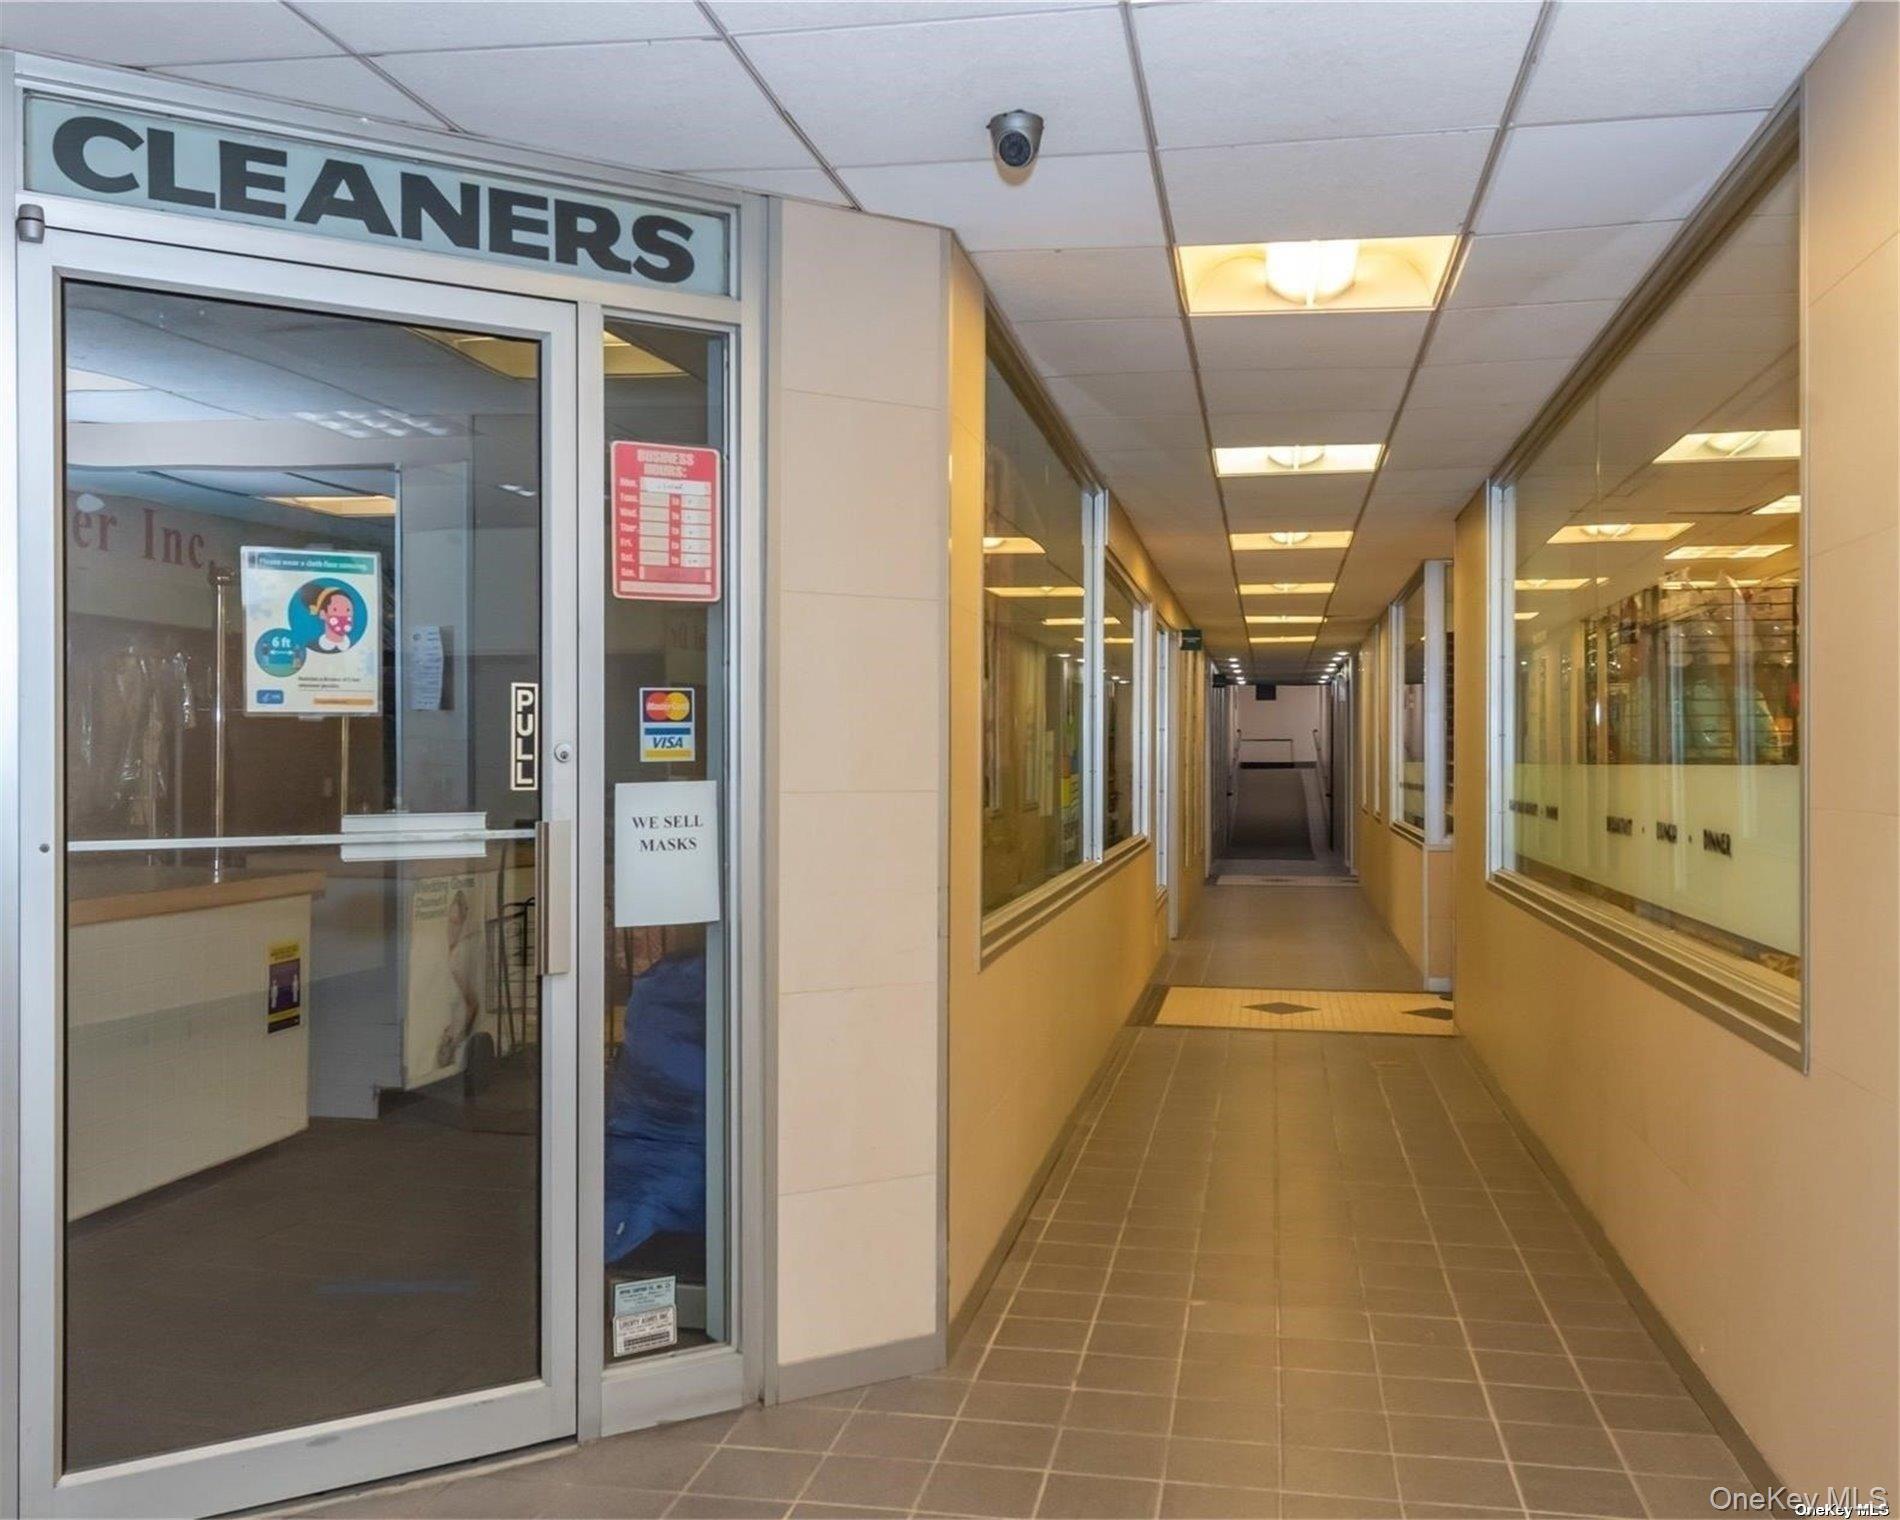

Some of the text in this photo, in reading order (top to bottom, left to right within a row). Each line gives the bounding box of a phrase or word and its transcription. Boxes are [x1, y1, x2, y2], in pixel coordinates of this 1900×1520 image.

[52, 115, 696, 285] CLEANERS
[271, 636, 291, 648] 6 ft
[516, 689, 534, 784] PULL
[653, 736, 684, 749] VISA
[632, 815, 703, 829] WE SELL
[640, 838, 698, 852] MASKS
